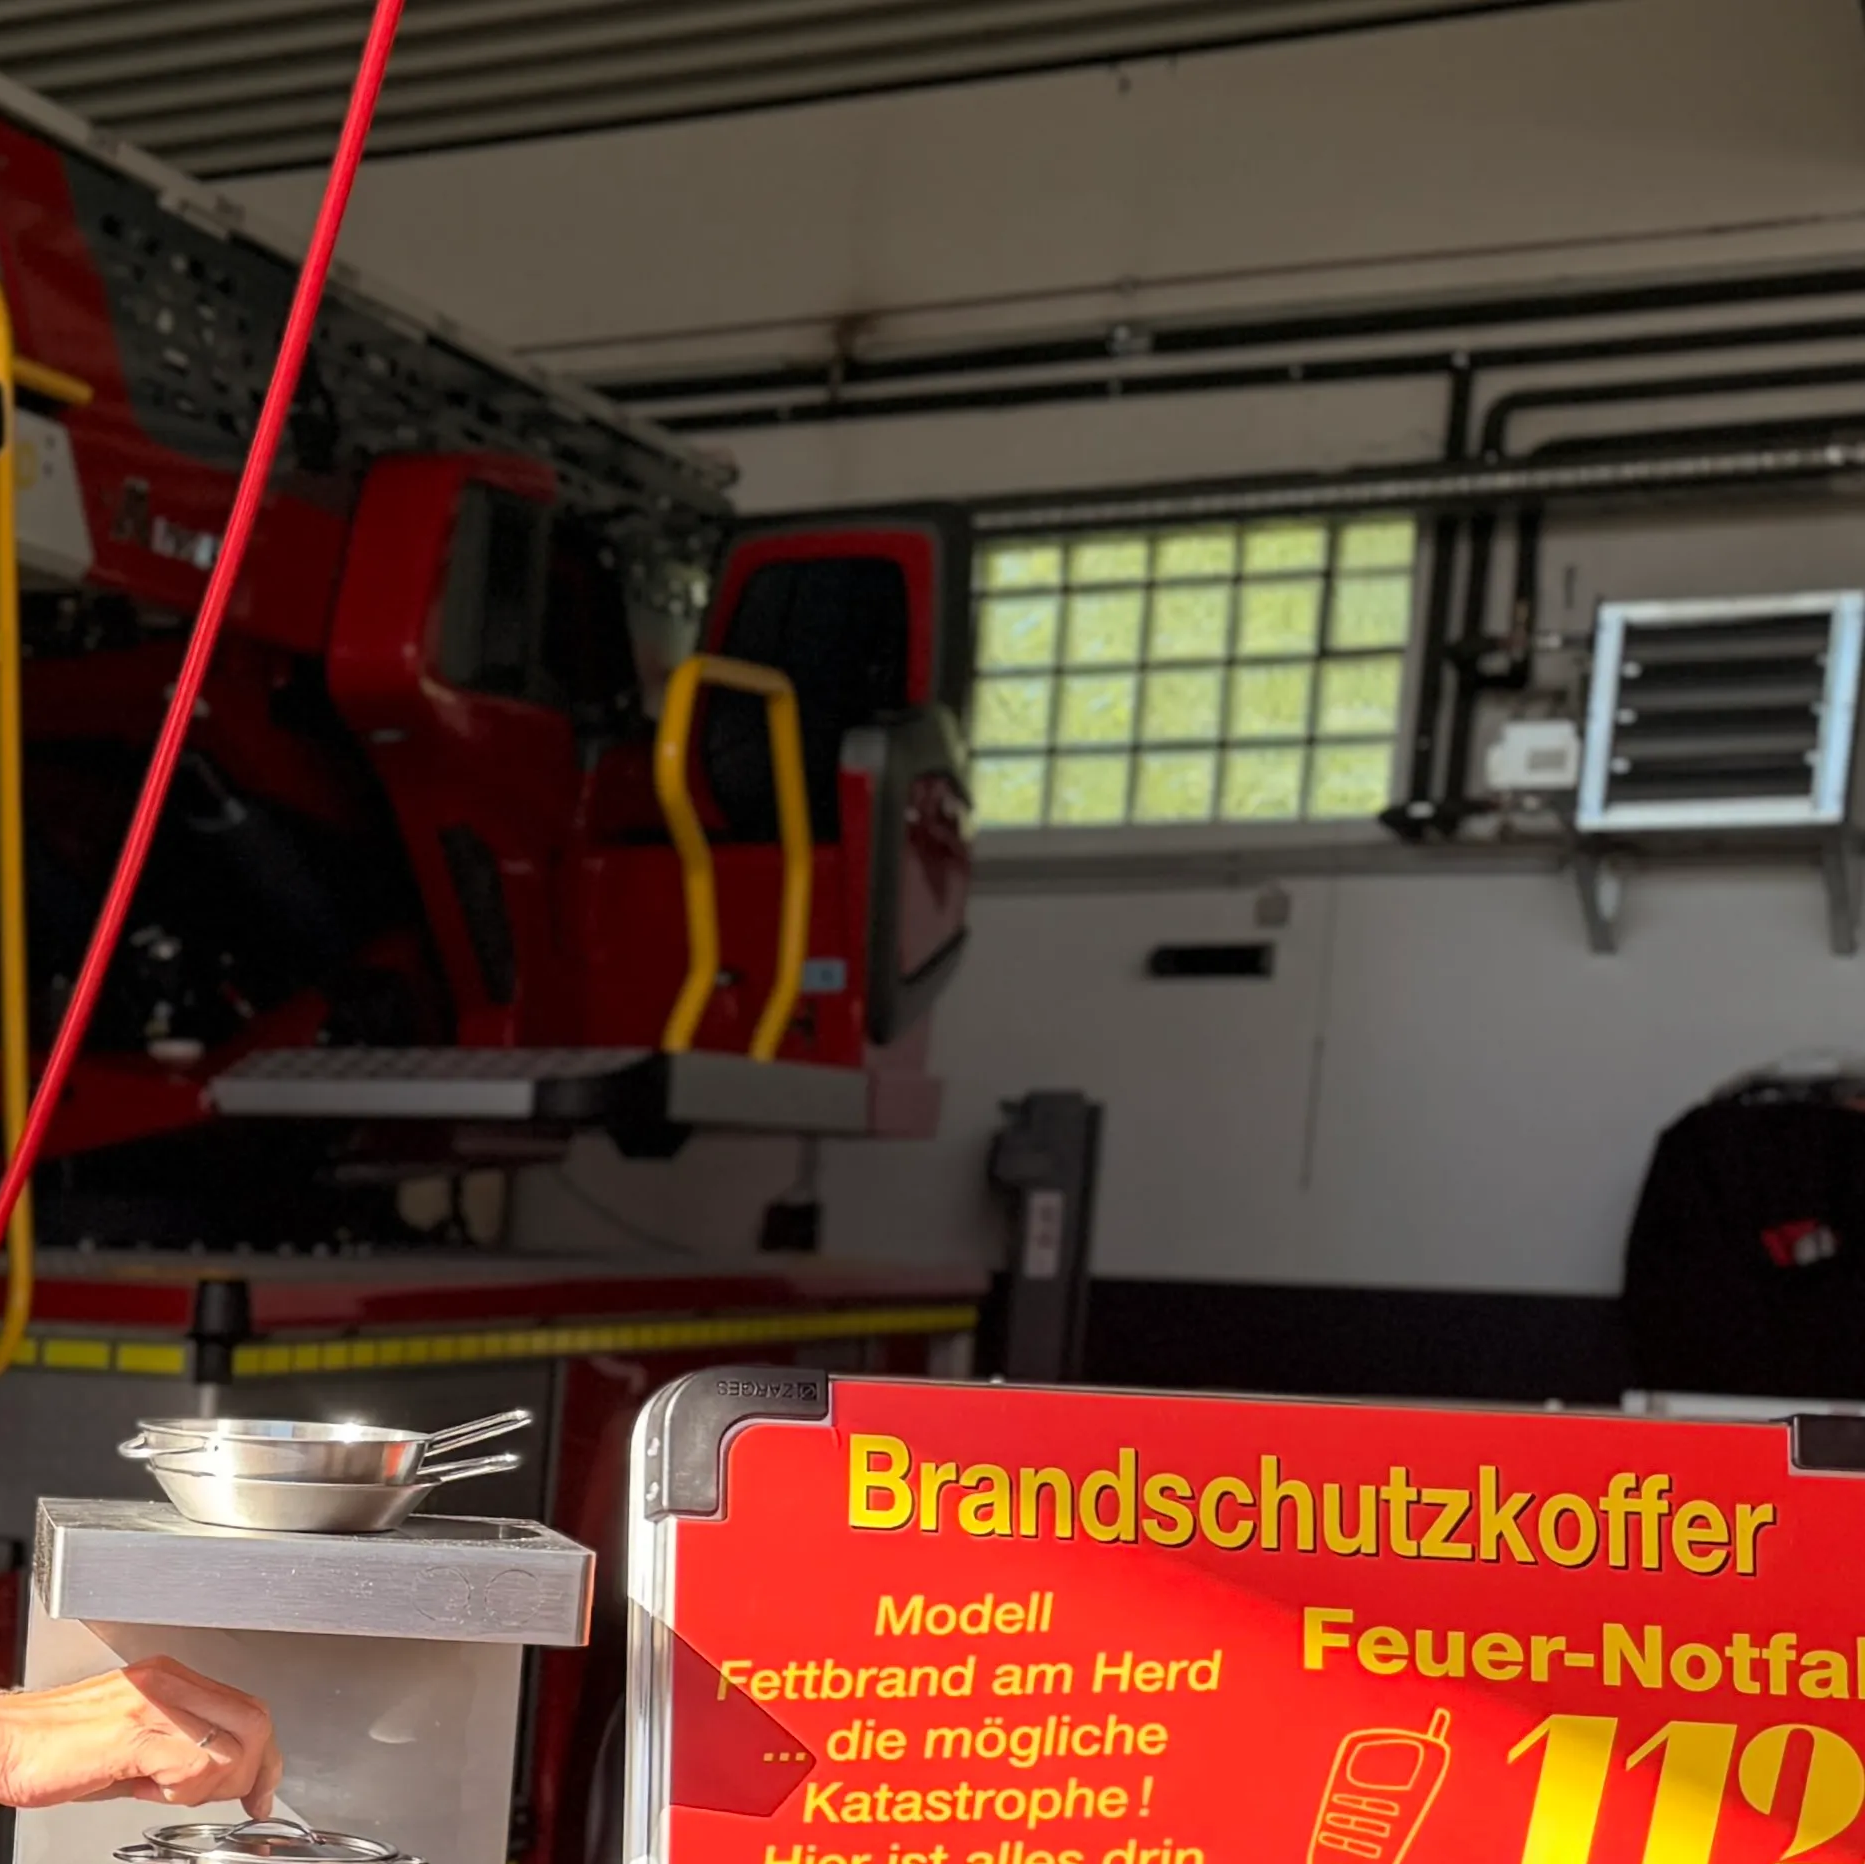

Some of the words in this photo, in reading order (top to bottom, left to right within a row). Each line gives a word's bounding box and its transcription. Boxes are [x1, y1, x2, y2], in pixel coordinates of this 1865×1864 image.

[716, 1382, 792, 1399] ZARGES
[847, 1433, 1776, 1577] Brandschutzkoffer
[875, 1592, 1053, 1638] Modell
[717, 1655, 975, 1702] Fettbrand
[991, 1660, 1073, 1696] am
[1092, 1650, 1223, 1693] Herd
[826, 1719, 908, 1762] die
[923, 1715, 1169, 1768] mögliche
